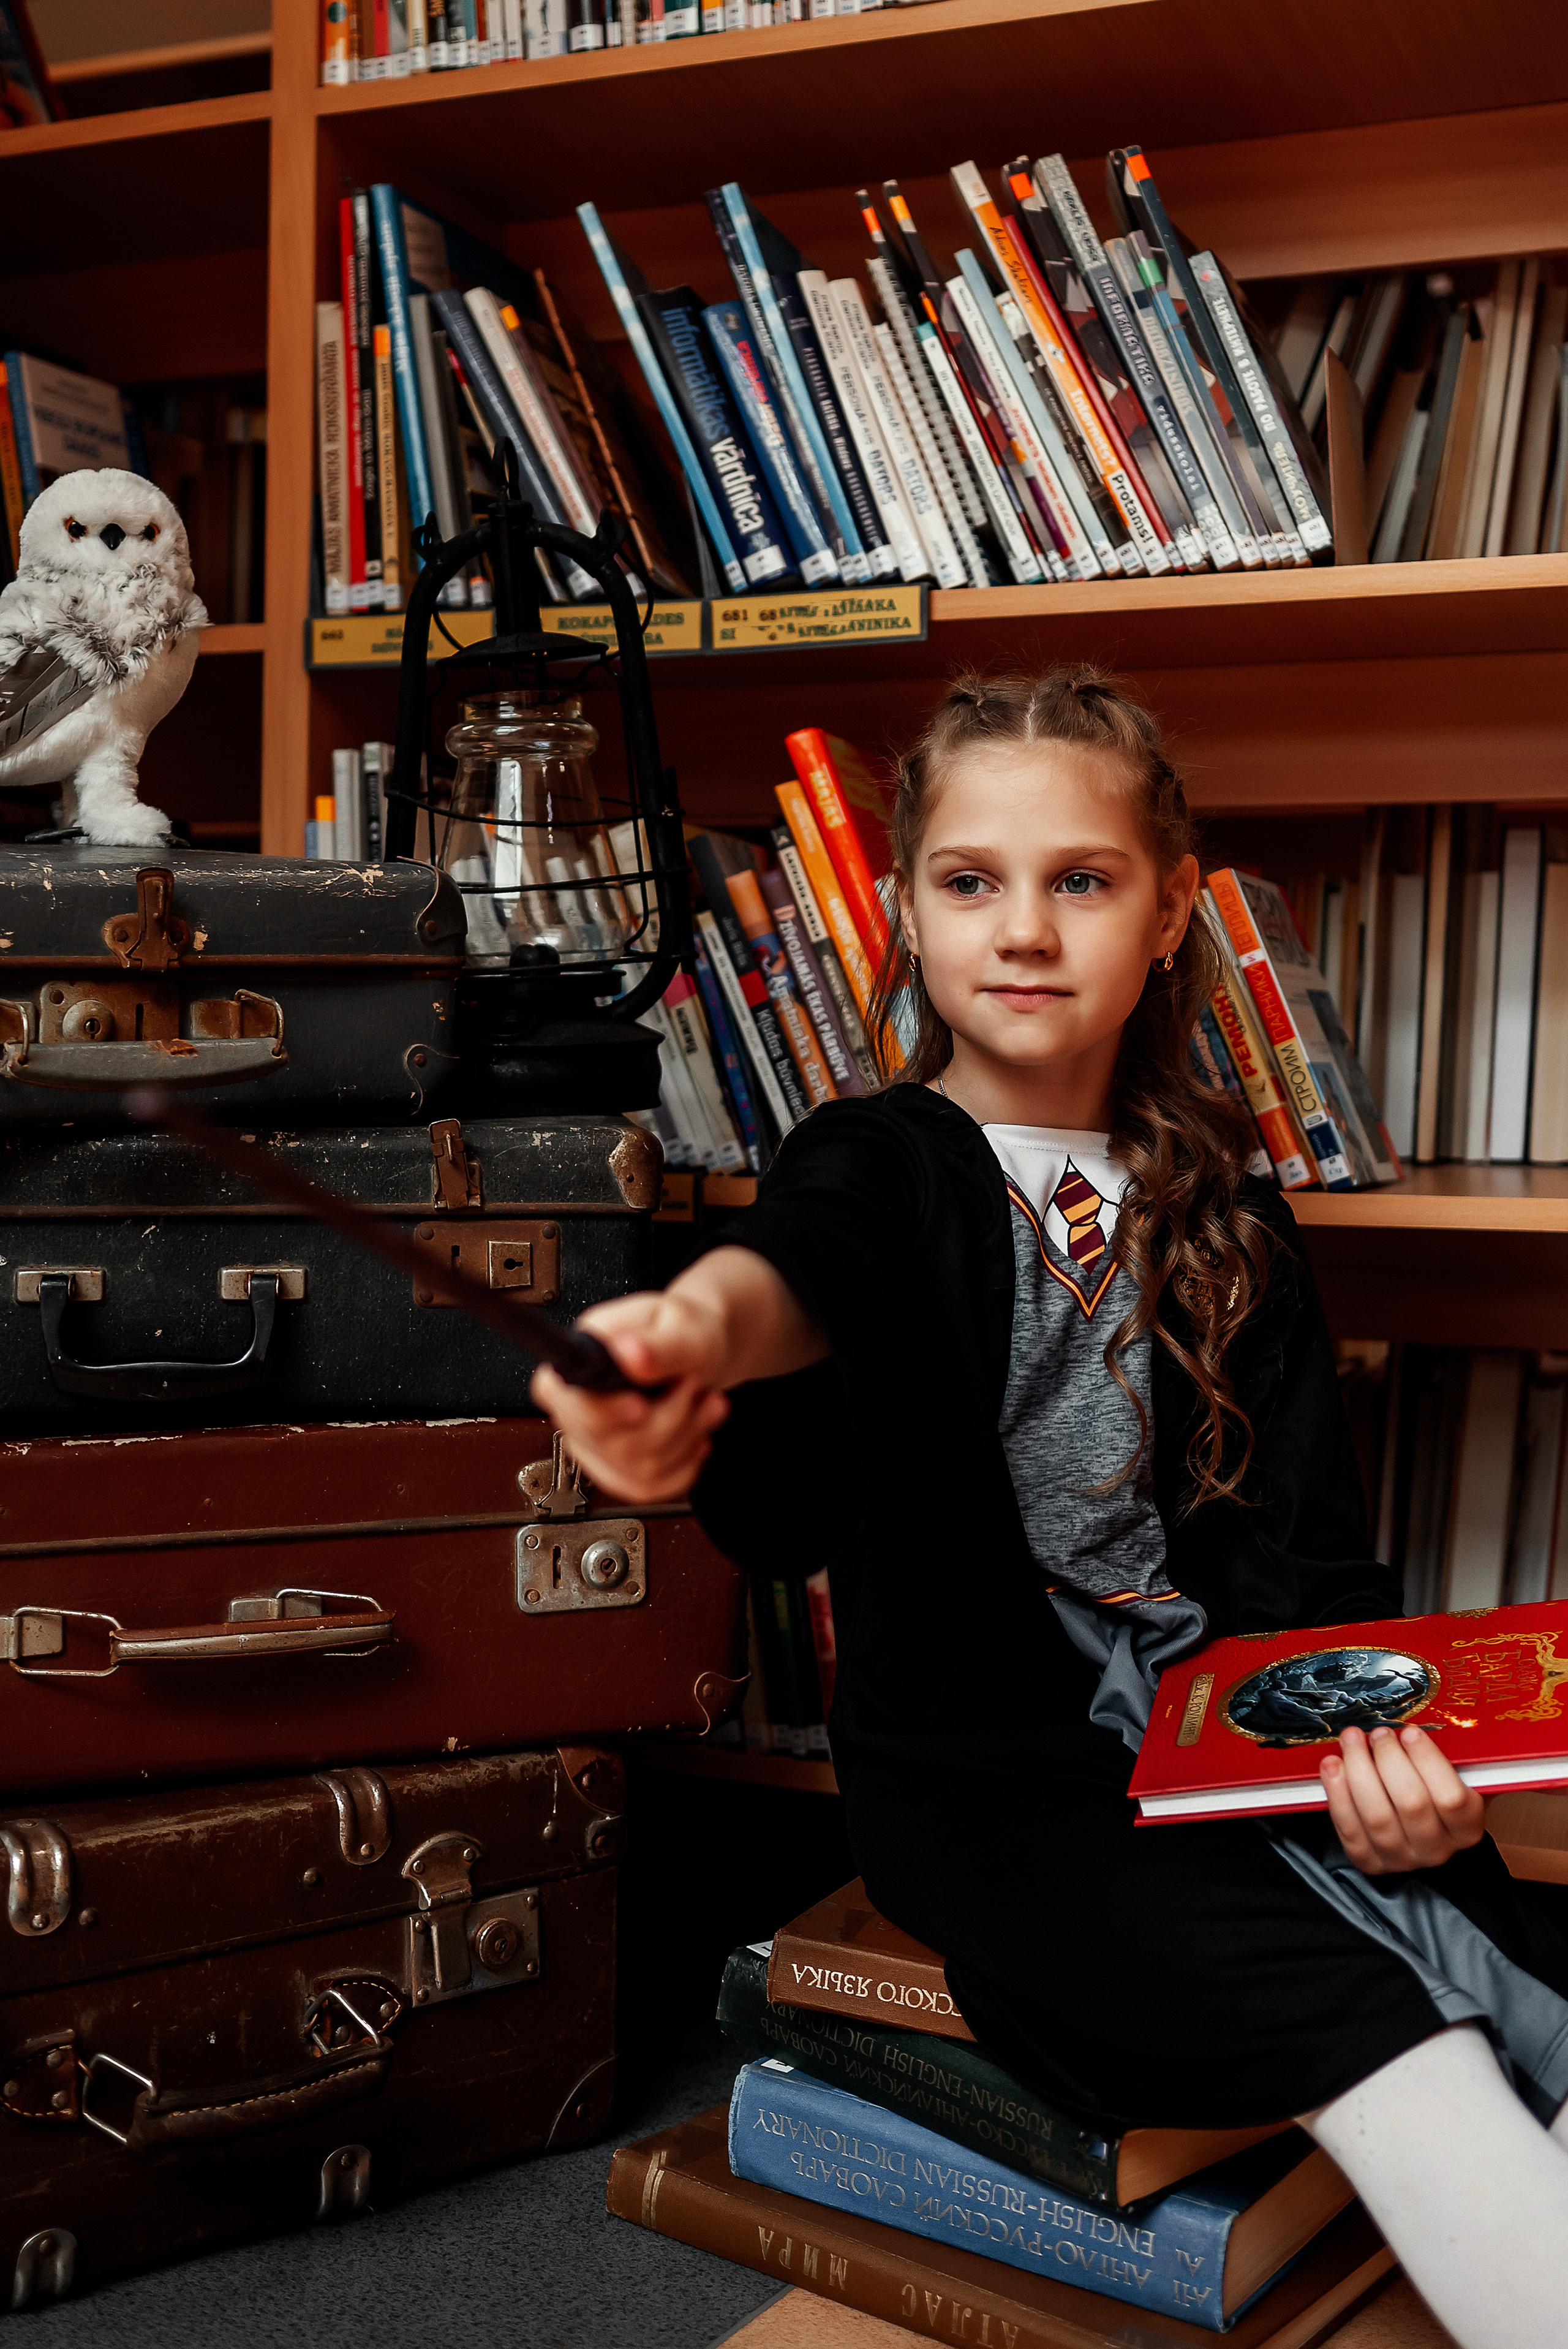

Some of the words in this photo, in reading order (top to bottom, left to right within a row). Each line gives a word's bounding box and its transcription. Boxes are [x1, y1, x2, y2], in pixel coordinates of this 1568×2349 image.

[1212, 297, 1248, 358] ИНТЕРНЕТЕ
[1237, 357, 1251, 369] В
[1241, 369, 1269, 413] РАБОТЕ
[1069, 390, 1115, 469] Internets?
[1260, 415, 1278, 433] ПО
[711, 436, 765, 535] vārdnīca
[864, 447, 897, 505] DATORS
[900, 457, 933, 516] DATORS
[1110, 475, 1152, 543] Protams!
[774, 904, 820, 991] DZĪVOJAMĀS
[1216, 880, 1254, 952] ТЕПЛИЦЫ
[767, 974, 816, 1061] Amatnieka
[1250, 967, 1288, 1042] ПАРНИКИ
[1281, 1043, 1317, 1113] СТРОИМ
[1476, 1649, 1521, 1703] БАРДА
[1183, 1703, 1202, 1735] РОУЛИНГ
[791, 1963, 873, 1997] ЯЗЫКА
[759, 2016, 837, 2067] СЛОВАРЬ
[883, 2044, 1053, 2141] RUSSIAN-ENGLISH
[752, 2106, 907, 2186] DICTIONARY
[788, 2150, 905, 2209] СЛОВАРЬ
[913, 2190, 1155, 2291] АНГЛО-РУССКИЙ
[914, 2156, 1156, 2258] ENGLISH-RUSSIAN
[756, 2223, 849, 2293] МИРА
[901, 2283, 1020, 2349] АТЛАС
